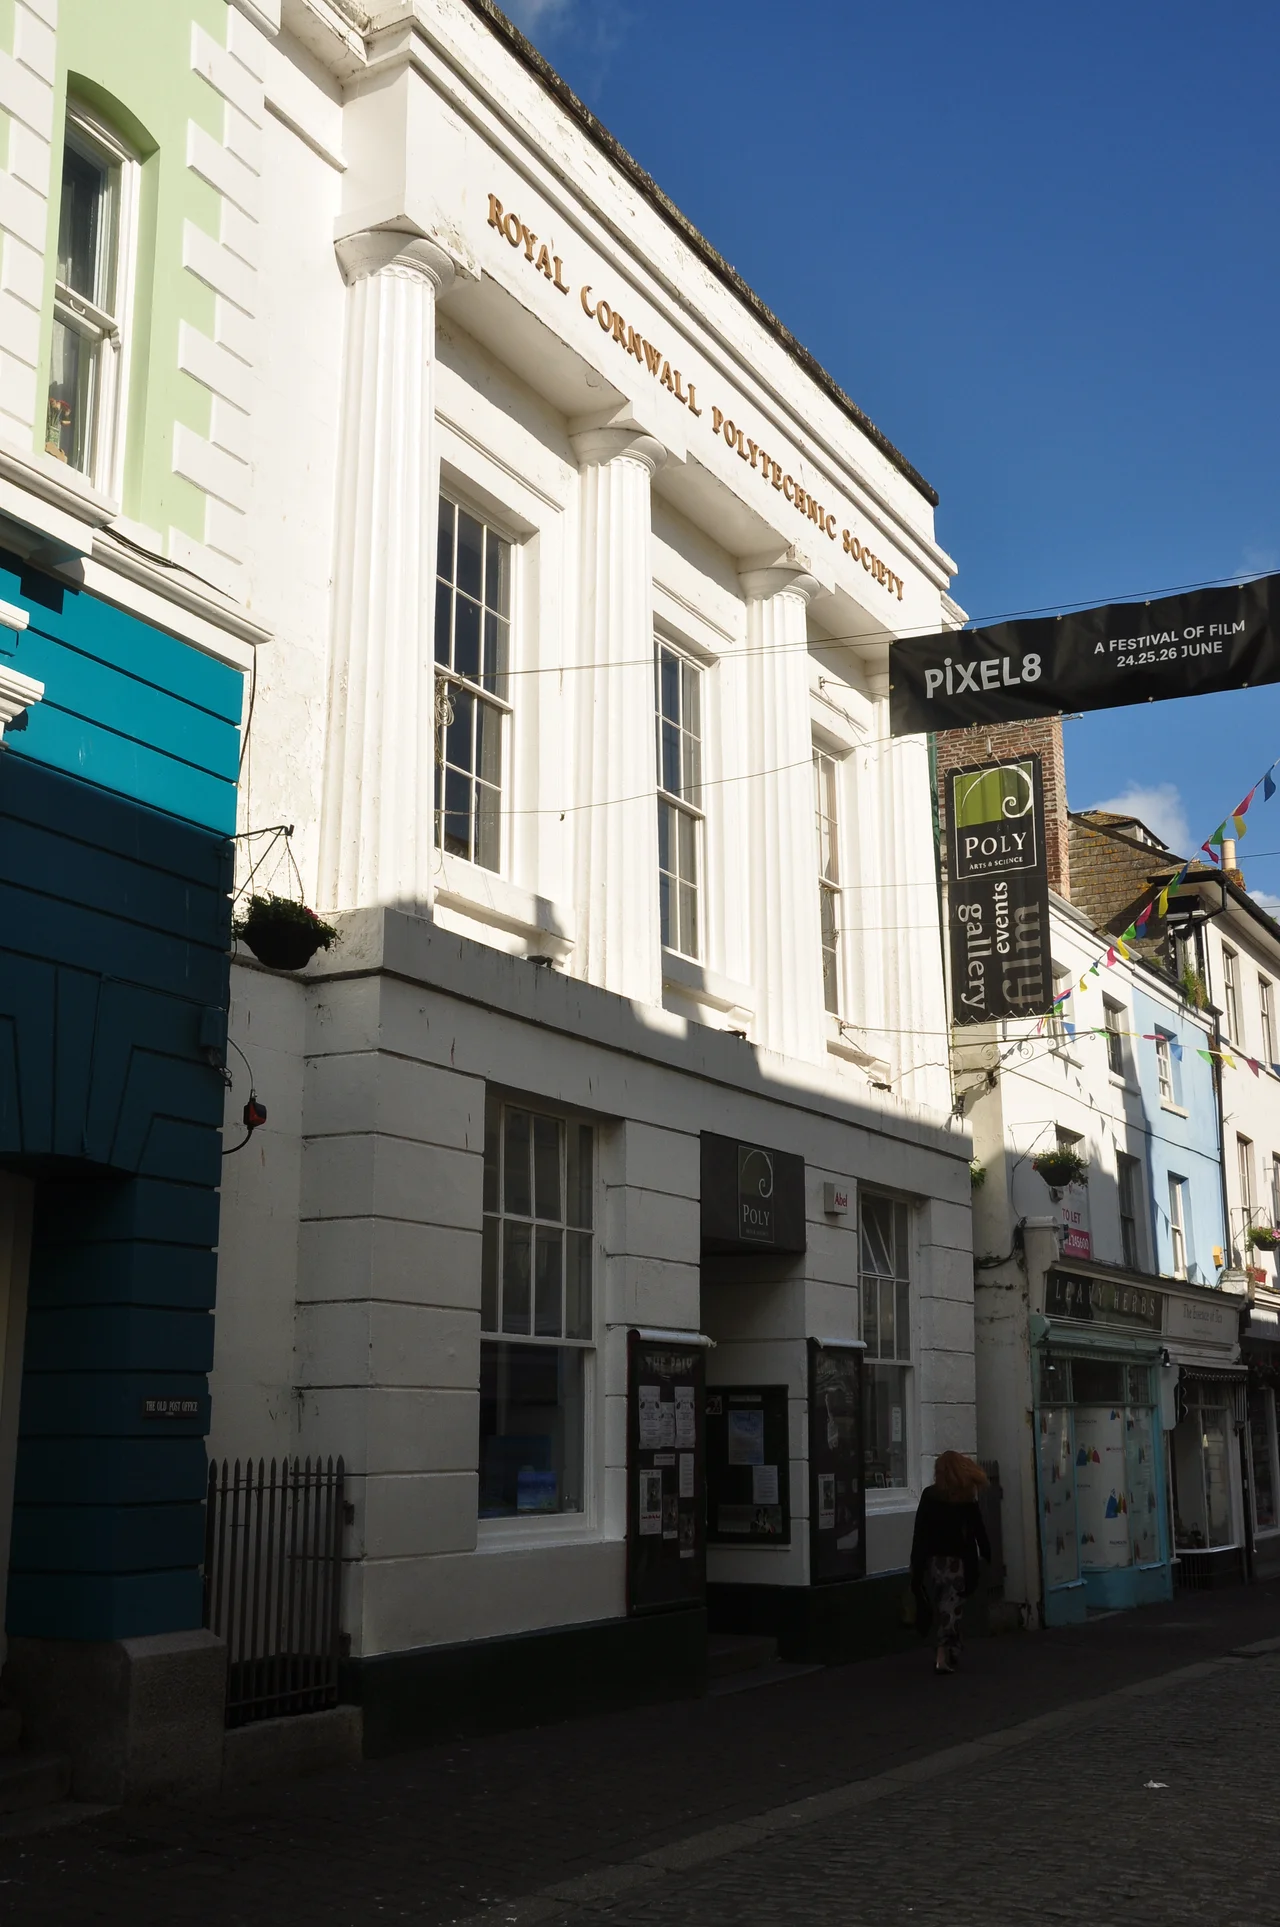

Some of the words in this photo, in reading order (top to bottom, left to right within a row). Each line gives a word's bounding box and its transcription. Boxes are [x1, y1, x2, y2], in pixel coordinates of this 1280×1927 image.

[487, 193, 569, 294] ROYAL
[580, 285, 702, 416] CORNWALL
[711, 405, 837, 540] POLYTECHNIC
[842, 529, 904, 601] SOCIETY
[1094, 642, 1105, 655] A
[1109, 630, 1179, 653] FESTIVAL
[1183, 625, 1206, 641] OF
[1209, 620, 1246, 638] FILM
[1116, 647, 1178, 668] 24.25.26
[1180, 641, 1223, 659] JUNE
[964, 831, 1027, 859] POLY
[969, 862, 987, 871] ARTS
[994, 856, 1023, 866] SCIENCE
[992, 881, 1011, 954] events
[957, 903, 993, 1010] gallery
[1001, 901, 1045, 1009] film
[742, 1204, 770, 1227] POLY
[1062, 1207, 1070, 1221] TO
[1070, 1210, 1081, 1225] LET
[1113, 1290, 1156, 1316] HERBS
[146, 1400, 156, 1412] THE
[157, 1400, 167, 1412] OLD
[169, 1400, 181, 1412] POST
[181, 1400, 198, 1412] OFFICE
